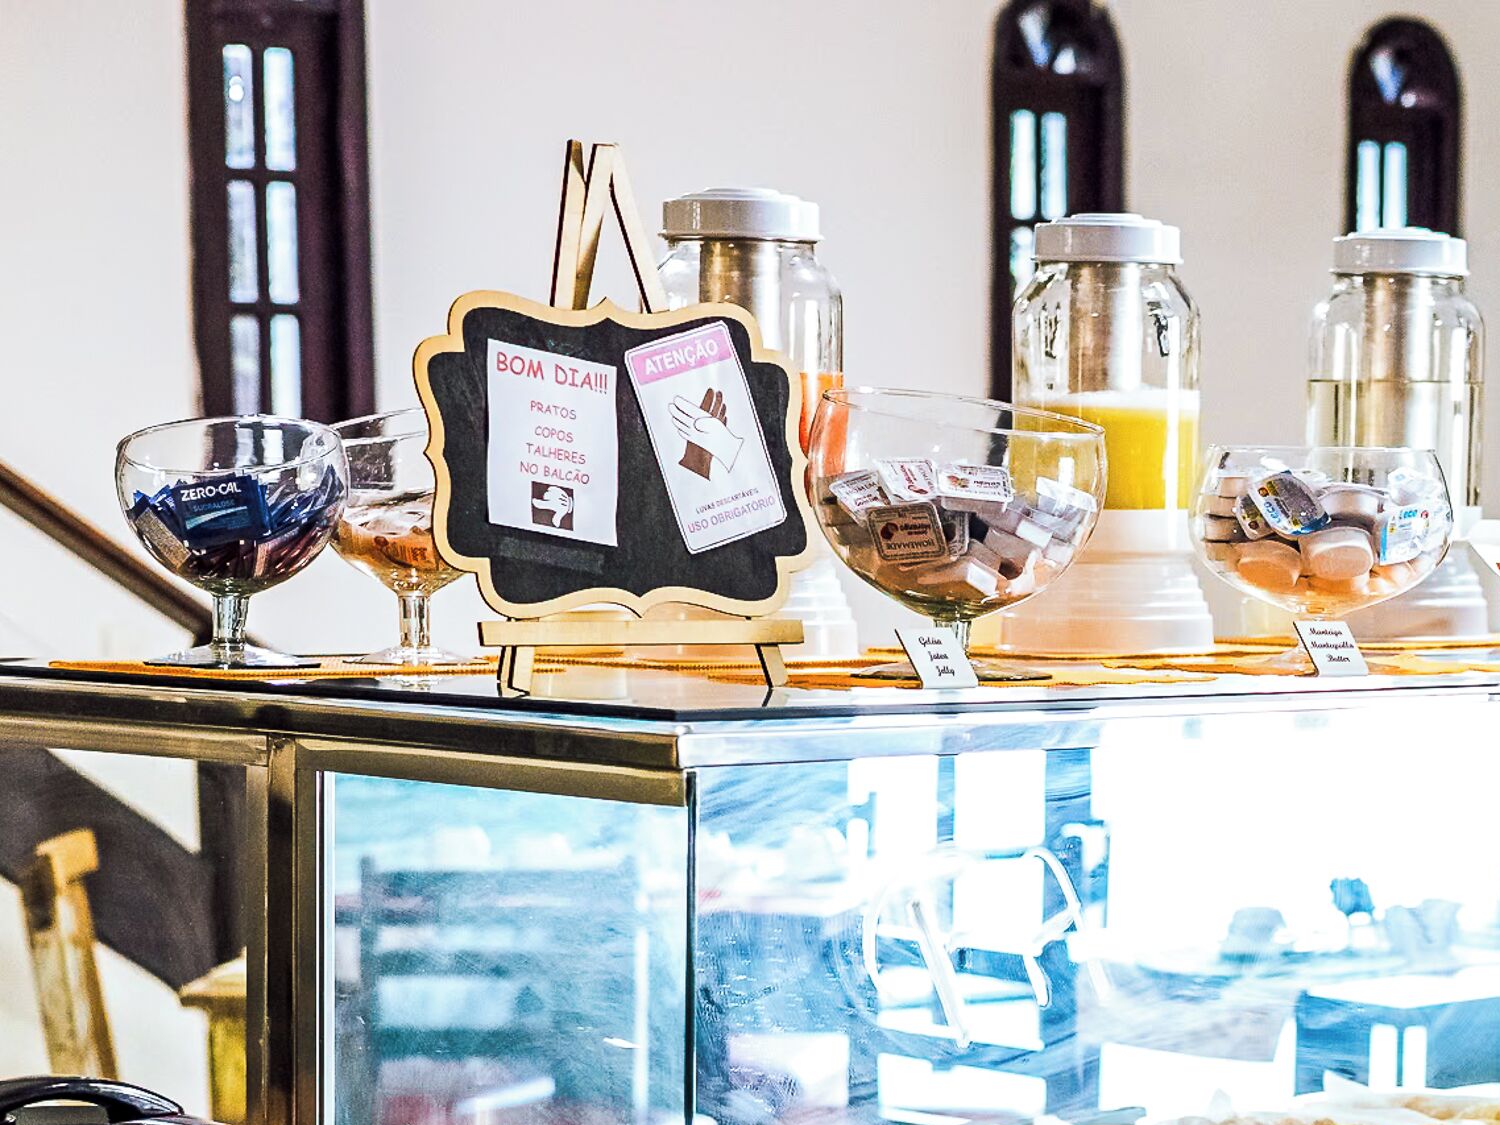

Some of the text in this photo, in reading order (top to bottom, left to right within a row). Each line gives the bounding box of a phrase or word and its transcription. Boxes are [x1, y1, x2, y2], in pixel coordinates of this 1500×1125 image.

[645, 338, 718, 375] ATENÇÃO
[496, 351, 608, 395] BOM DIA!!!
[530, 400, 577, 420] PRATOS
[535, 426, 574, 443] COPOS
[526, 443, 586, 465] TALHERES
[520, 461, 590, 485] NO BALCÃO
[688, 518, 709, 533] USO
[936, 665, 955, 677] Jelly
